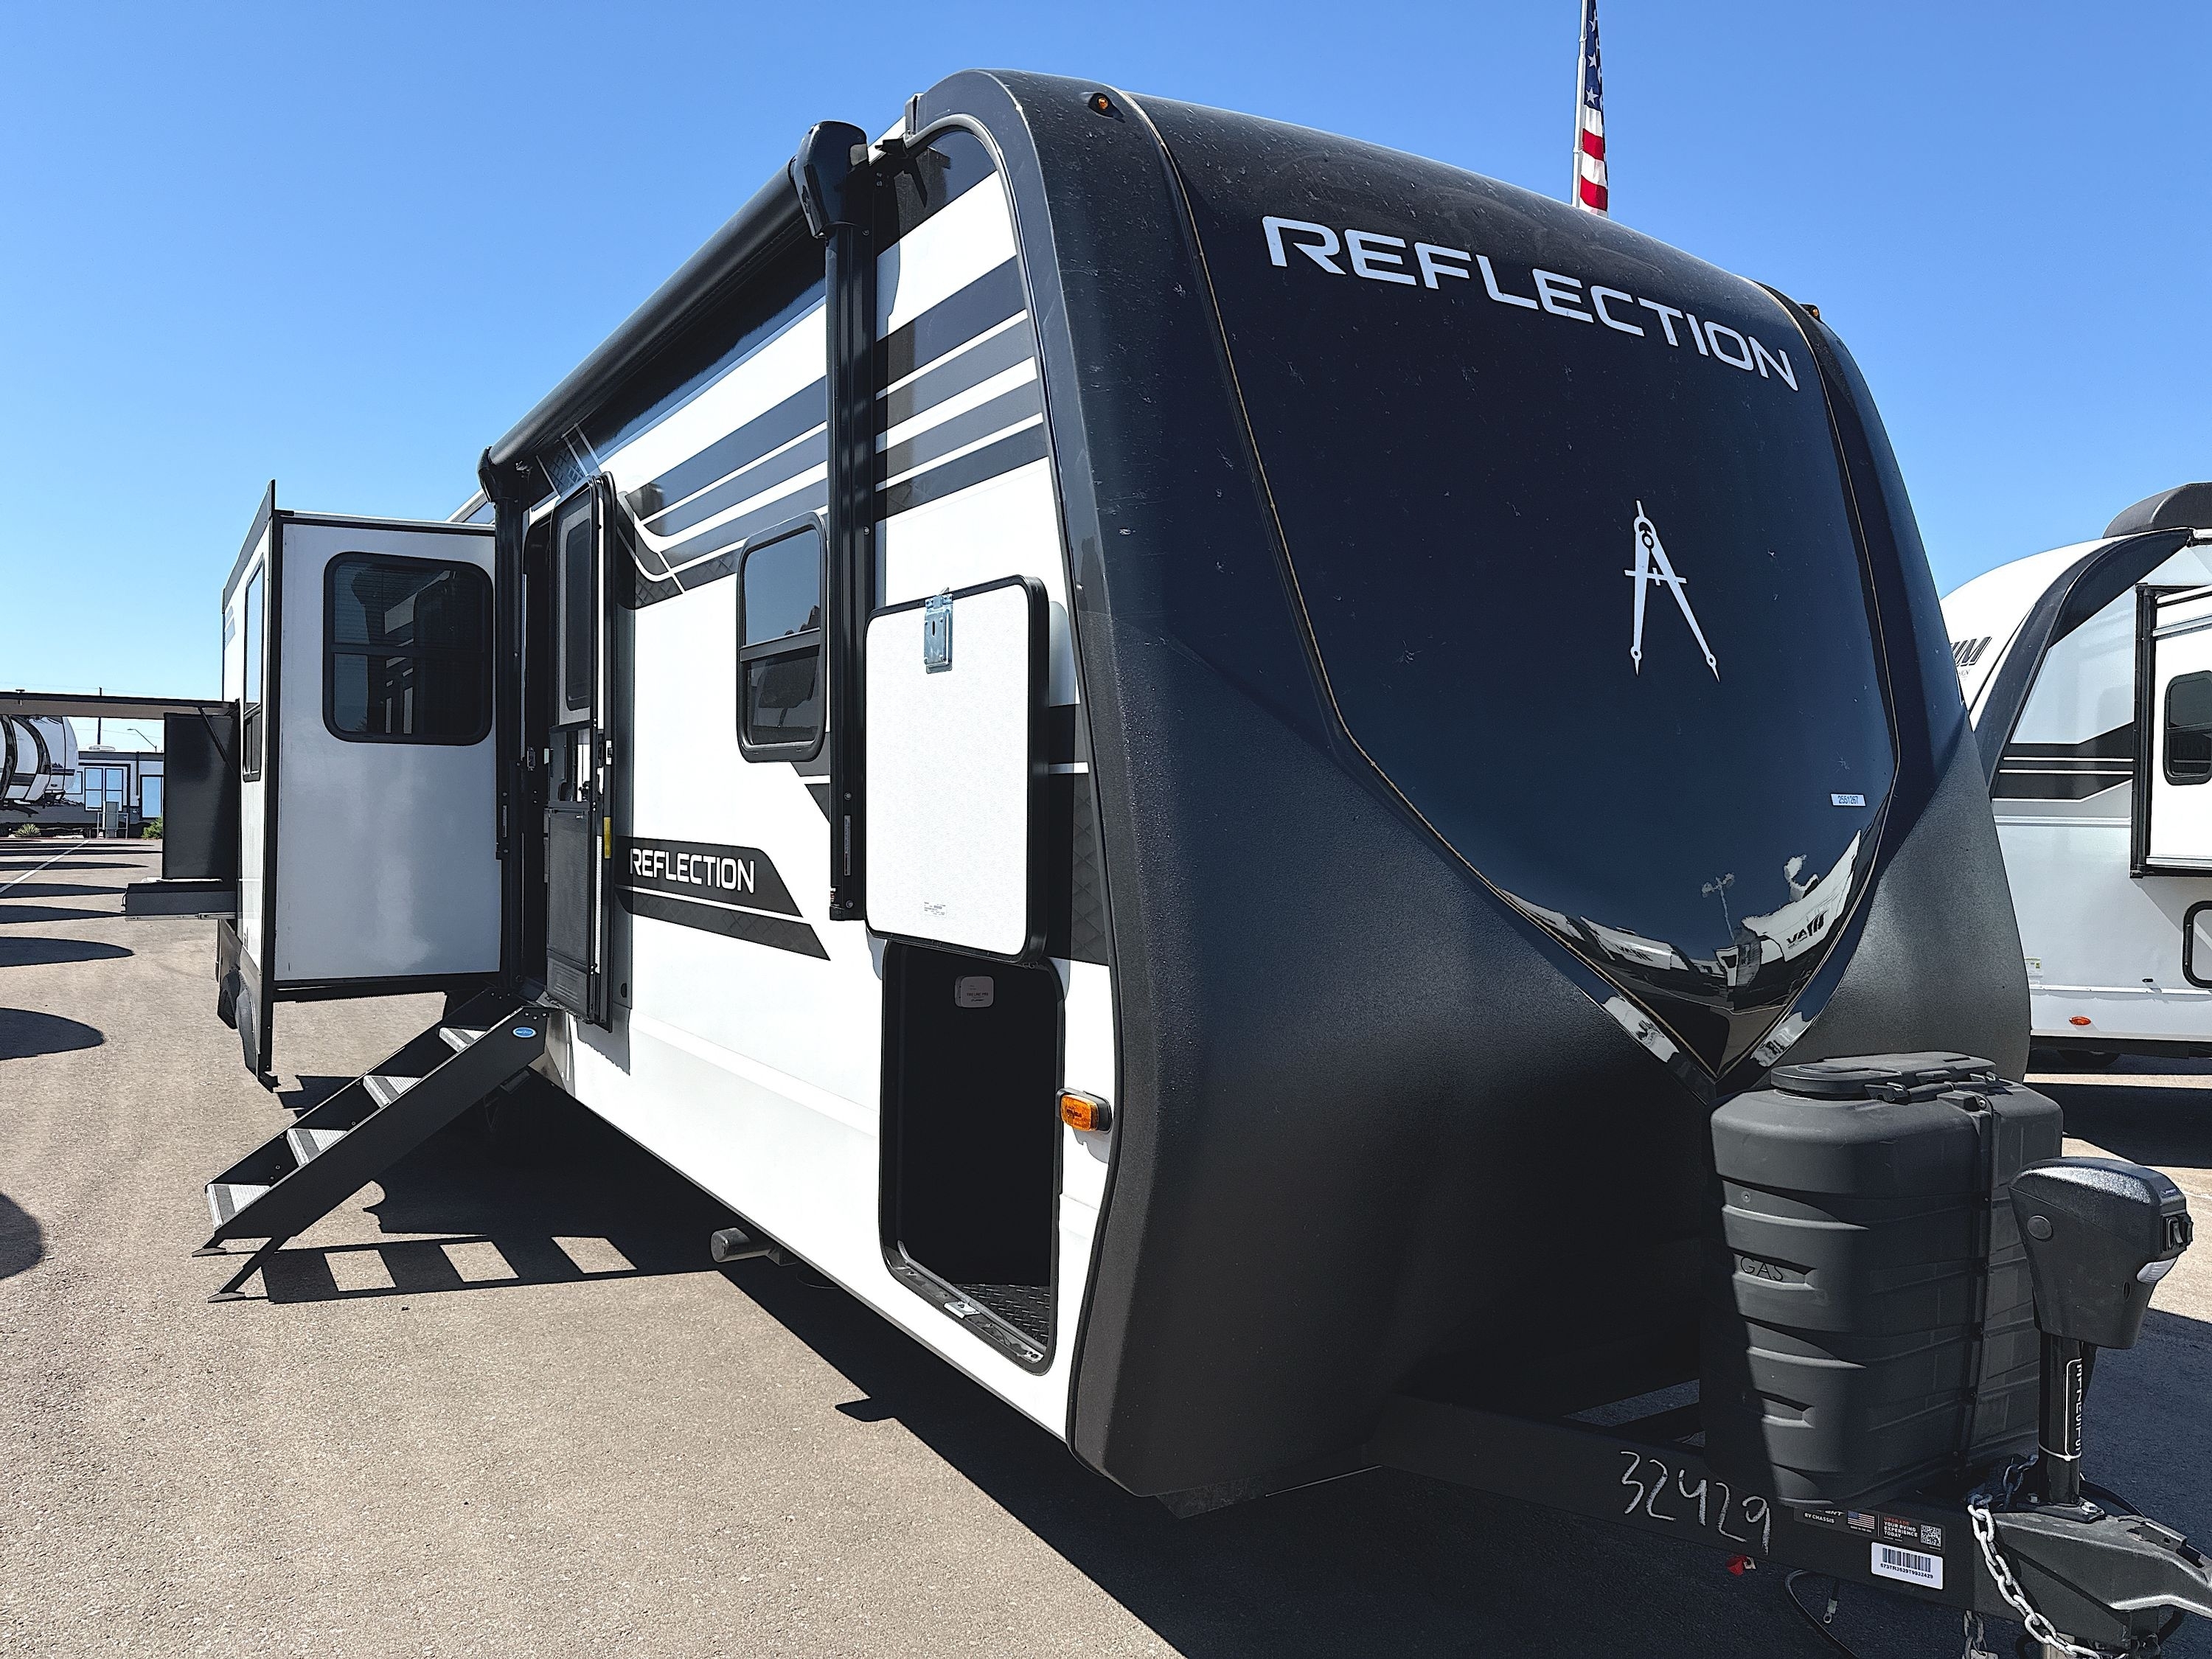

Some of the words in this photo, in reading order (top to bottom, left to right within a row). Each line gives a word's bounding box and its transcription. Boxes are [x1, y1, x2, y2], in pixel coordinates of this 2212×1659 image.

[1262, 215, 1799, 392] REFLECTION
[630, 848, 754, 894] REFLECTION
[1740, 1256, 1784, 1281] GAS
[1620, 1451, 1771, 1556] 32429
[1812, 1514, 1835, 1523] CHASSIS
[1884, 1526, 1918, 1537] EXPERIENCE
